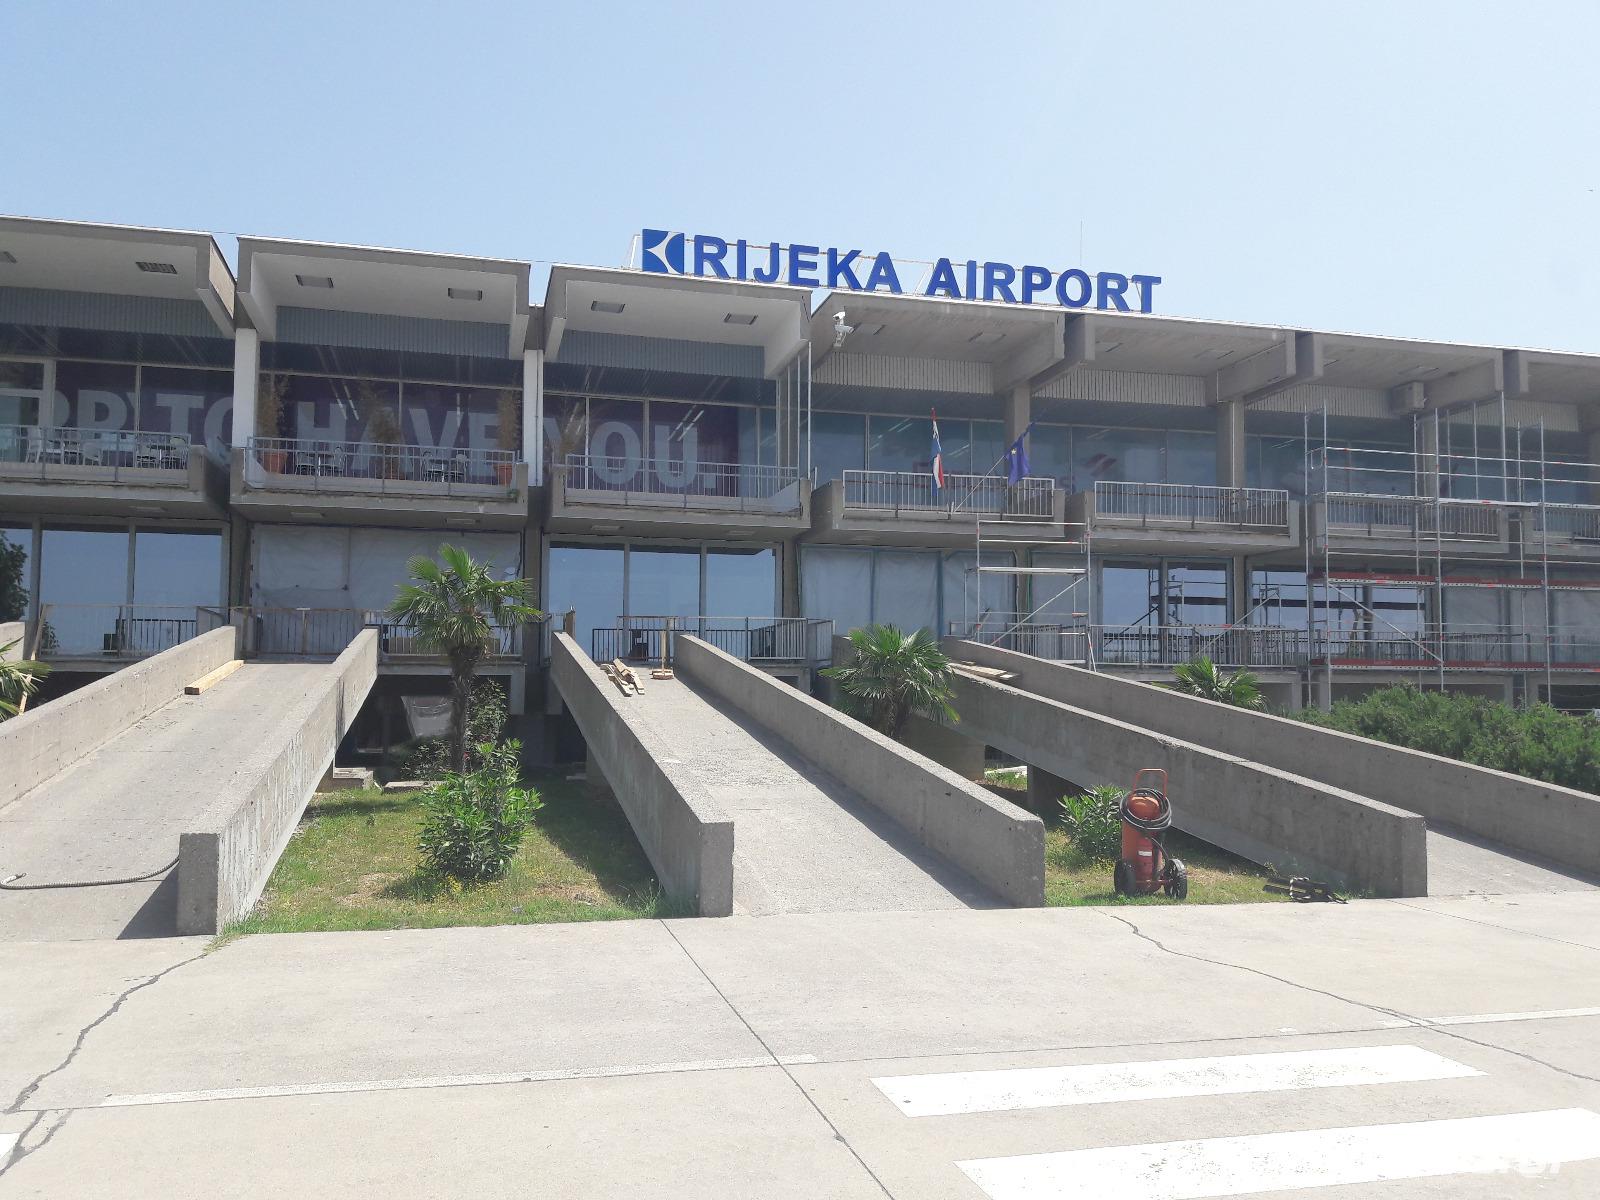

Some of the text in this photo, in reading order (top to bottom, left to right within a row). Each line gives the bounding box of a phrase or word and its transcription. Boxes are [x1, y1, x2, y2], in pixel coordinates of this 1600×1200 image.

[694, 235, 1162, 313] RIJEKA AIRPORT
[297, 401, 500, 477] HAVE
